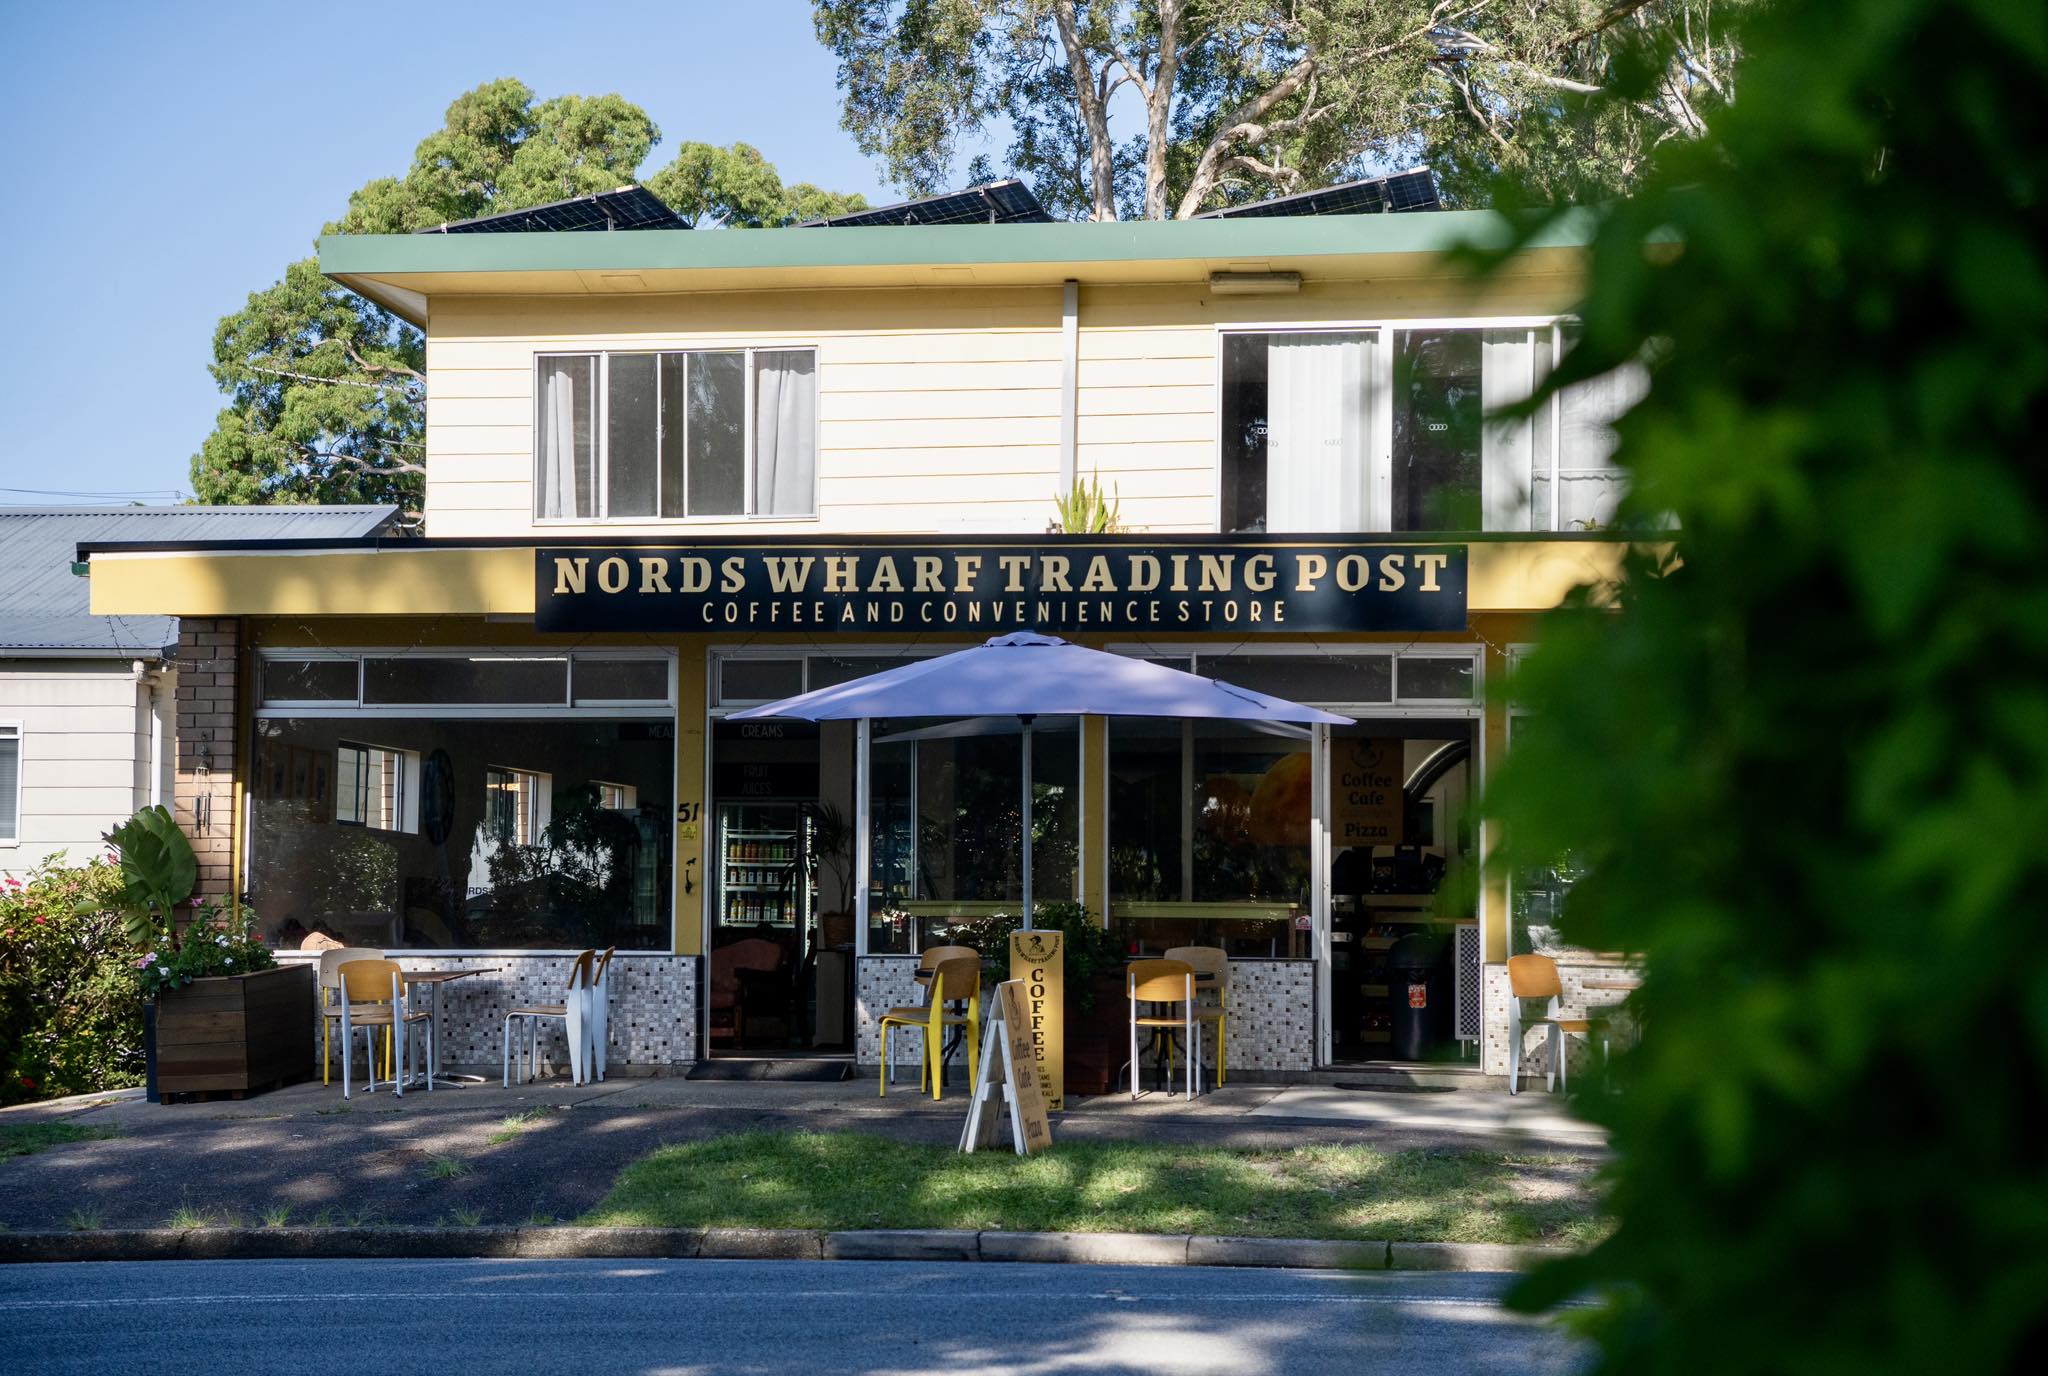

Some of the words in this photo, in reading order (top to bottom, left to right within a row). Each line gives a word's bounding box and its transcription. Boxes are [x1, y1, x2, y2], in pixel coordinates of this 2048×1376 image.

[553, 556, 746, 594] NORDS
[762, 555, 982, 593] WHARF
[999, 554, 1278, 593] TRADING
[1295, 554, 1448, 592] POST
[702, 601, 824, 623] COFFEE
[841, 601, 904, 622] AND
[921, 600, 1160, 622] CONVENIENCE
[1178, 600, 1285, 622] STORE
[741, 724, 784, 738] CREAMS
[1341, 772, 1393, 788] Coffee
[1349, 790, 1385, 805] Cafe
[677, 802, 700, 822] 51
[1344, 822, 1388, 837] Pizza
[1030, 968, 1045, 1061] COFFEE
